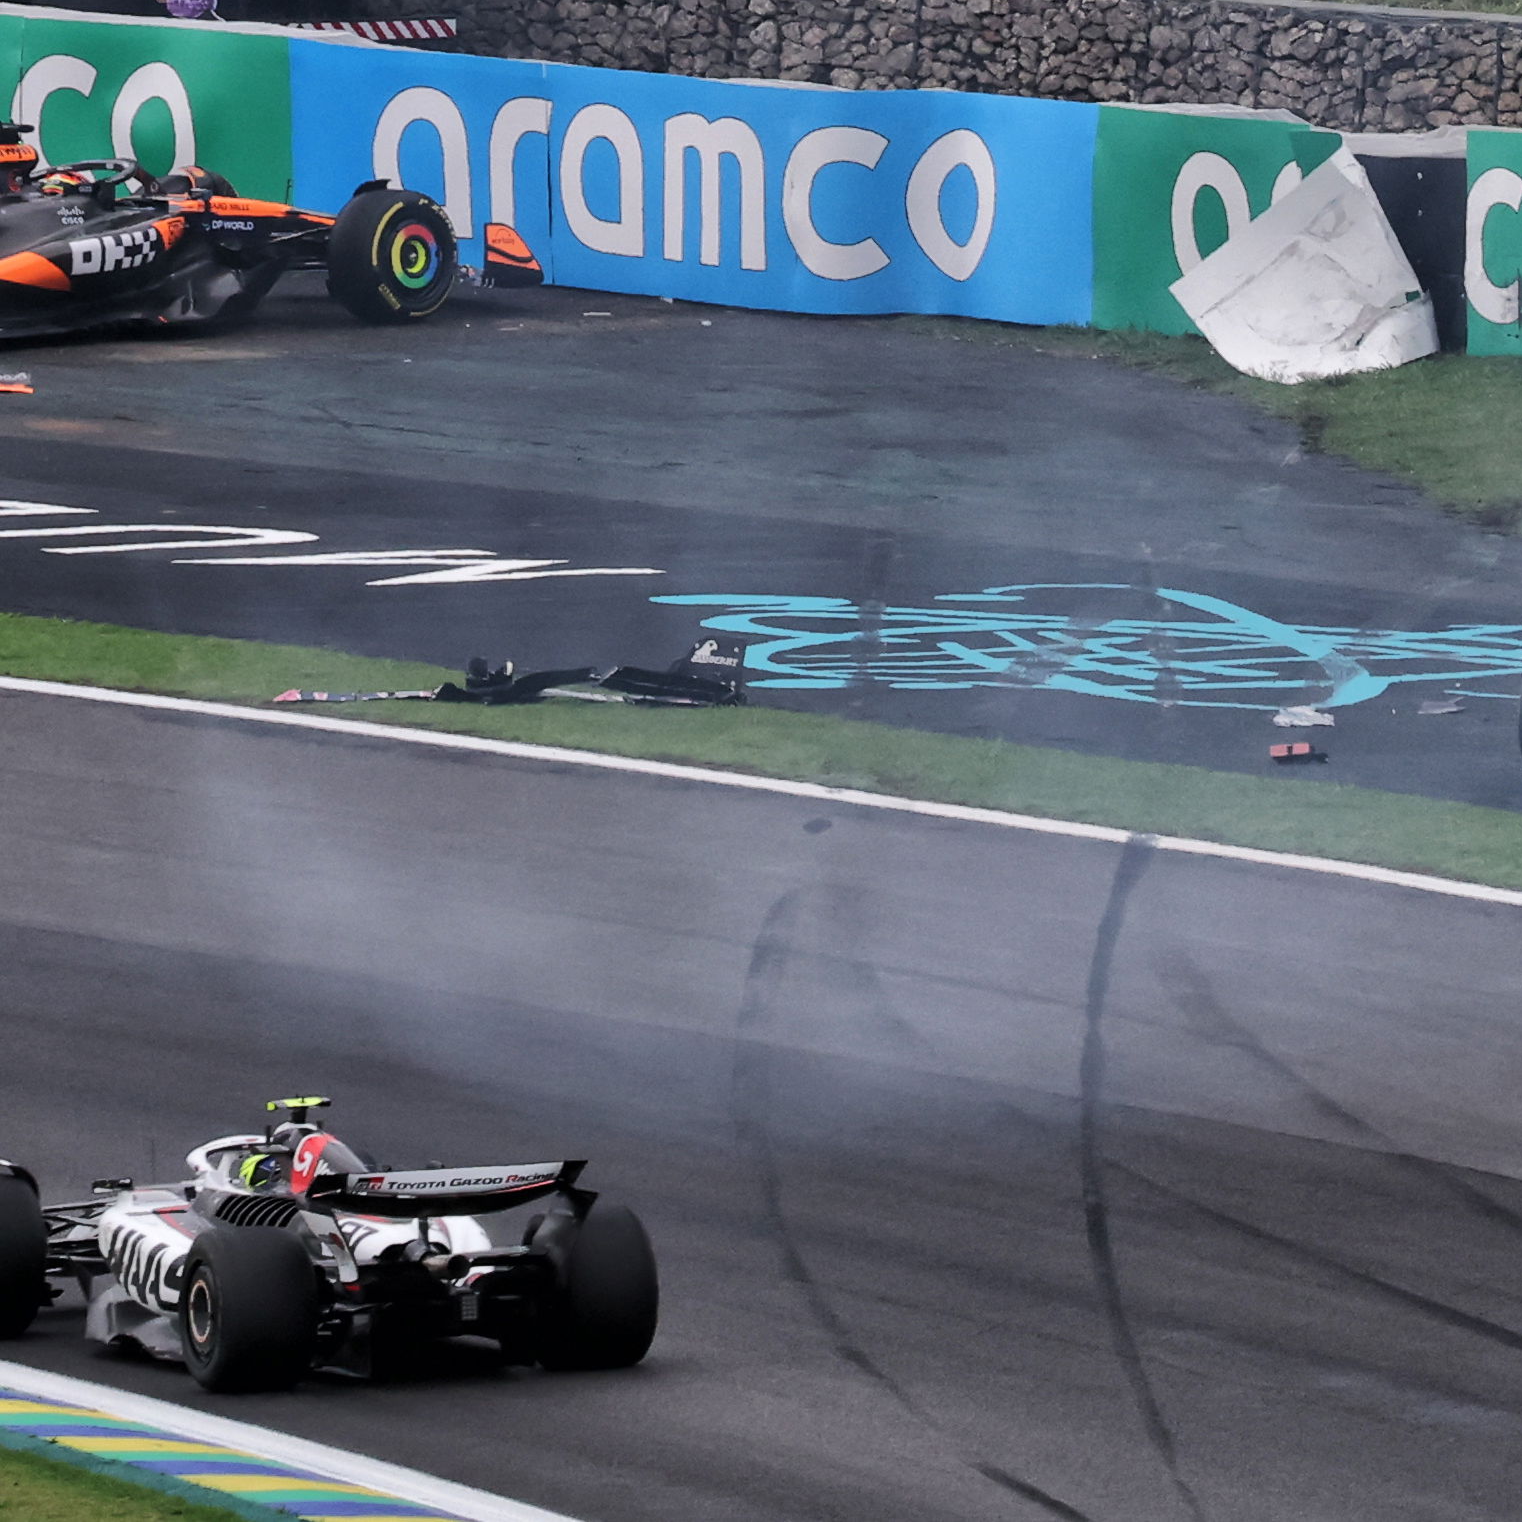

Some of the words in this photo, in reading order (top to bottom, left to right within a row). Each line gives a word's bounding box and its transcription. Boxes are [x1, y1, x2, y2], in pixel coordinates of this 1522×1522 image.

[372, 86, 996, 282] aramco
[387, 1181, 446, 1191] TOYOTA
[450, 1177, 503, 1188] GAZOO
[506, 1173, 556, 1185] Racing
